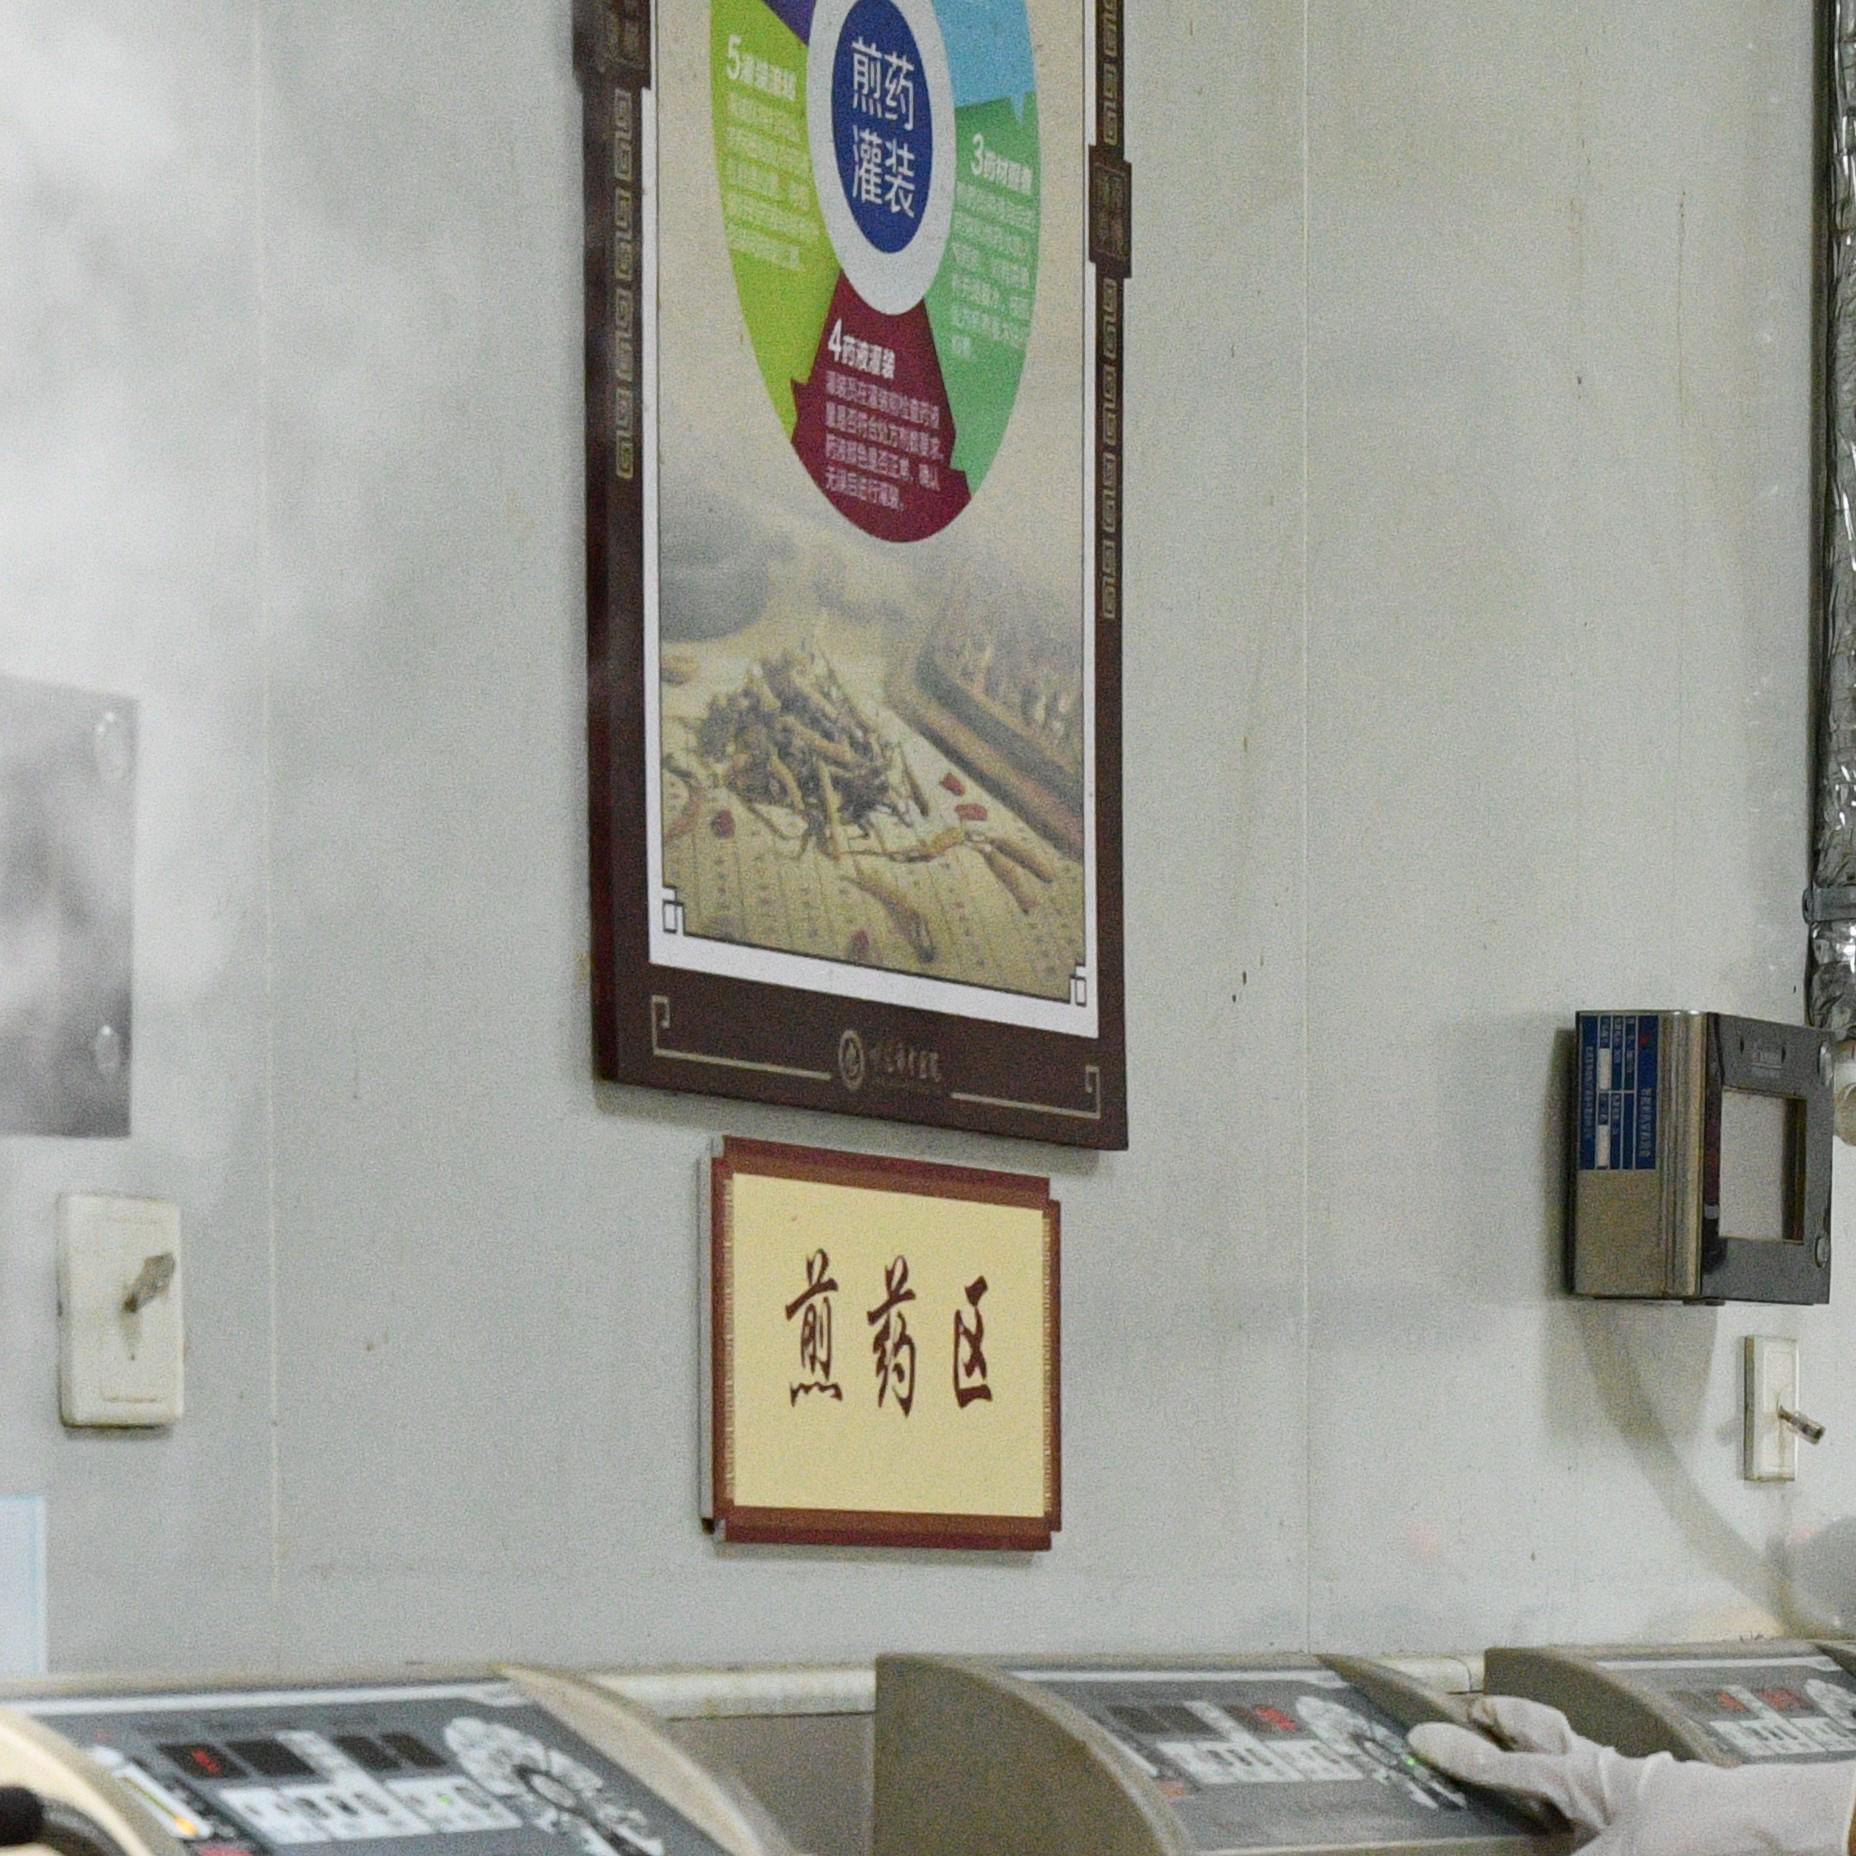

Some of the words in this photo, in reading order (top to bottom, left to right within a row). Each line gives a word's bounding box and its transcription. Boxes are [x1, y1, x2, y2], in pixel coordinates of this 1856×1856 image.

[851, 41, 915, 131] 煎药
[851, 129, 915, 218] 灌装
[784, 1248, 993, 1417] 煎药区
